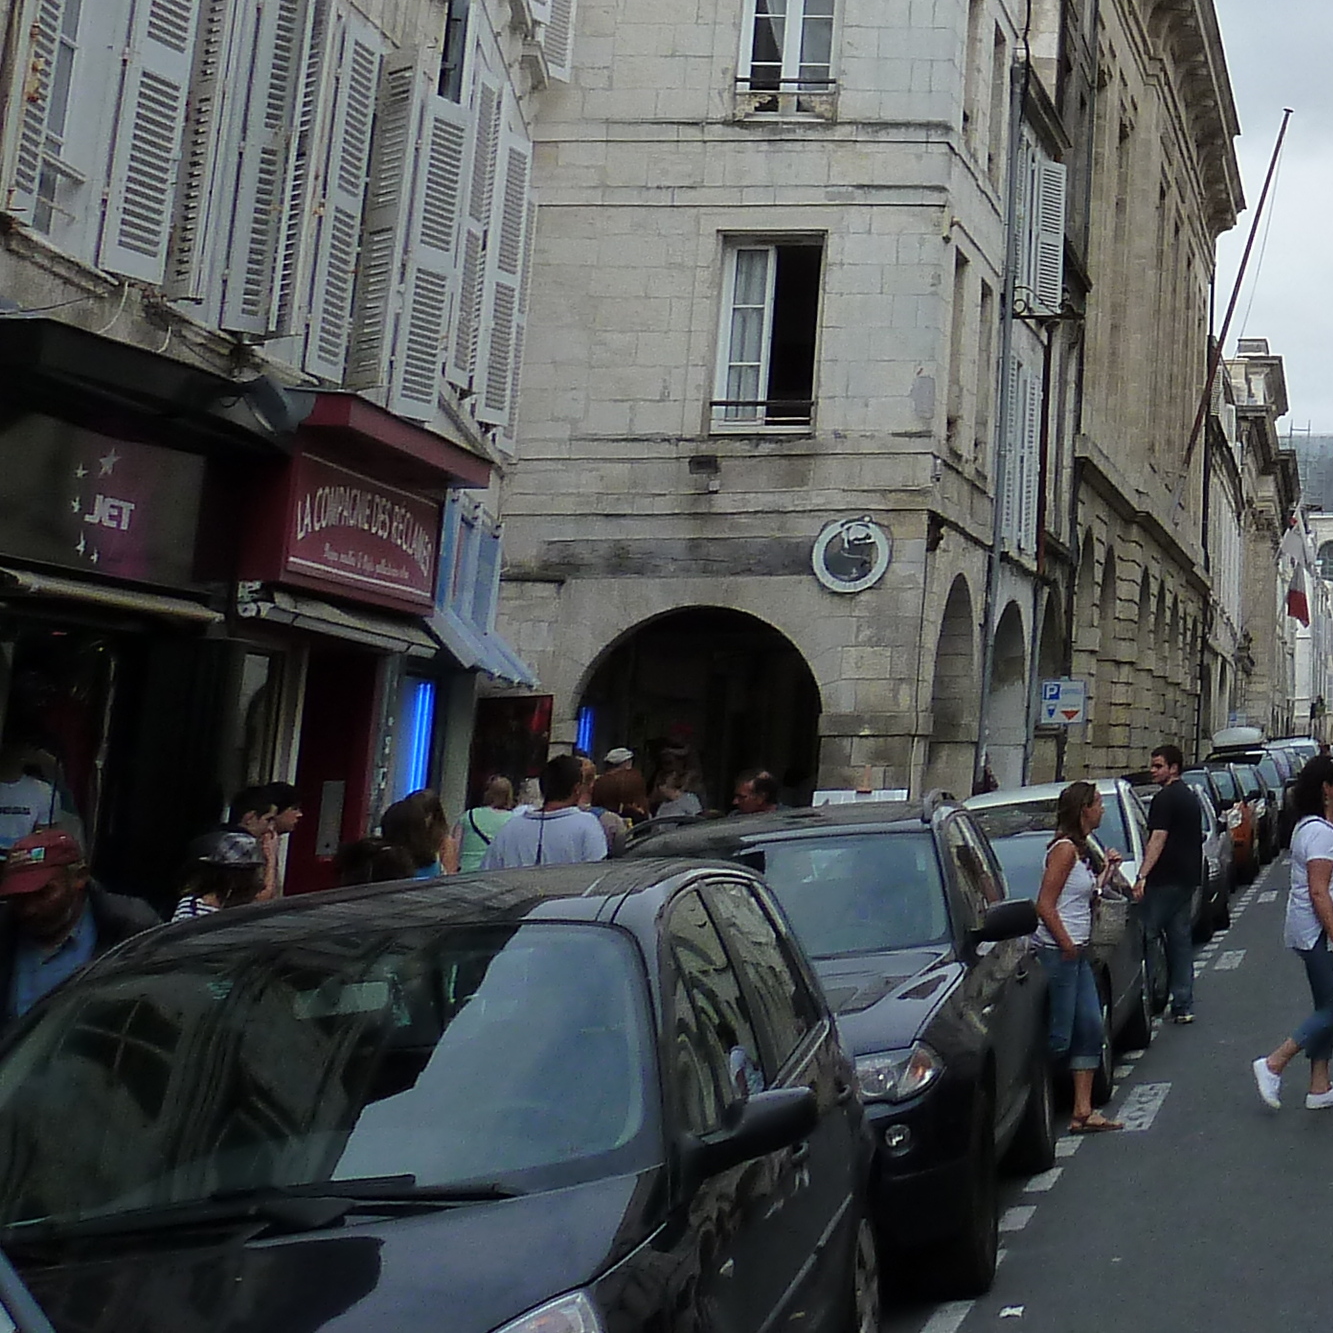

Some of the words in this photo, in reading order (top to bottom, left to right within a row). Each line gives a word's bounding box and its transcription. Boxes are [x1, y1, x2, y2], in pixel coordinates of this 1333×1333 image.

[83, 493, 136, 531] JET
[296, 493, 312, 541] LA
[313, 485, 372, 532] COMPAGNIE
[371, 493, 391, 541] DES
